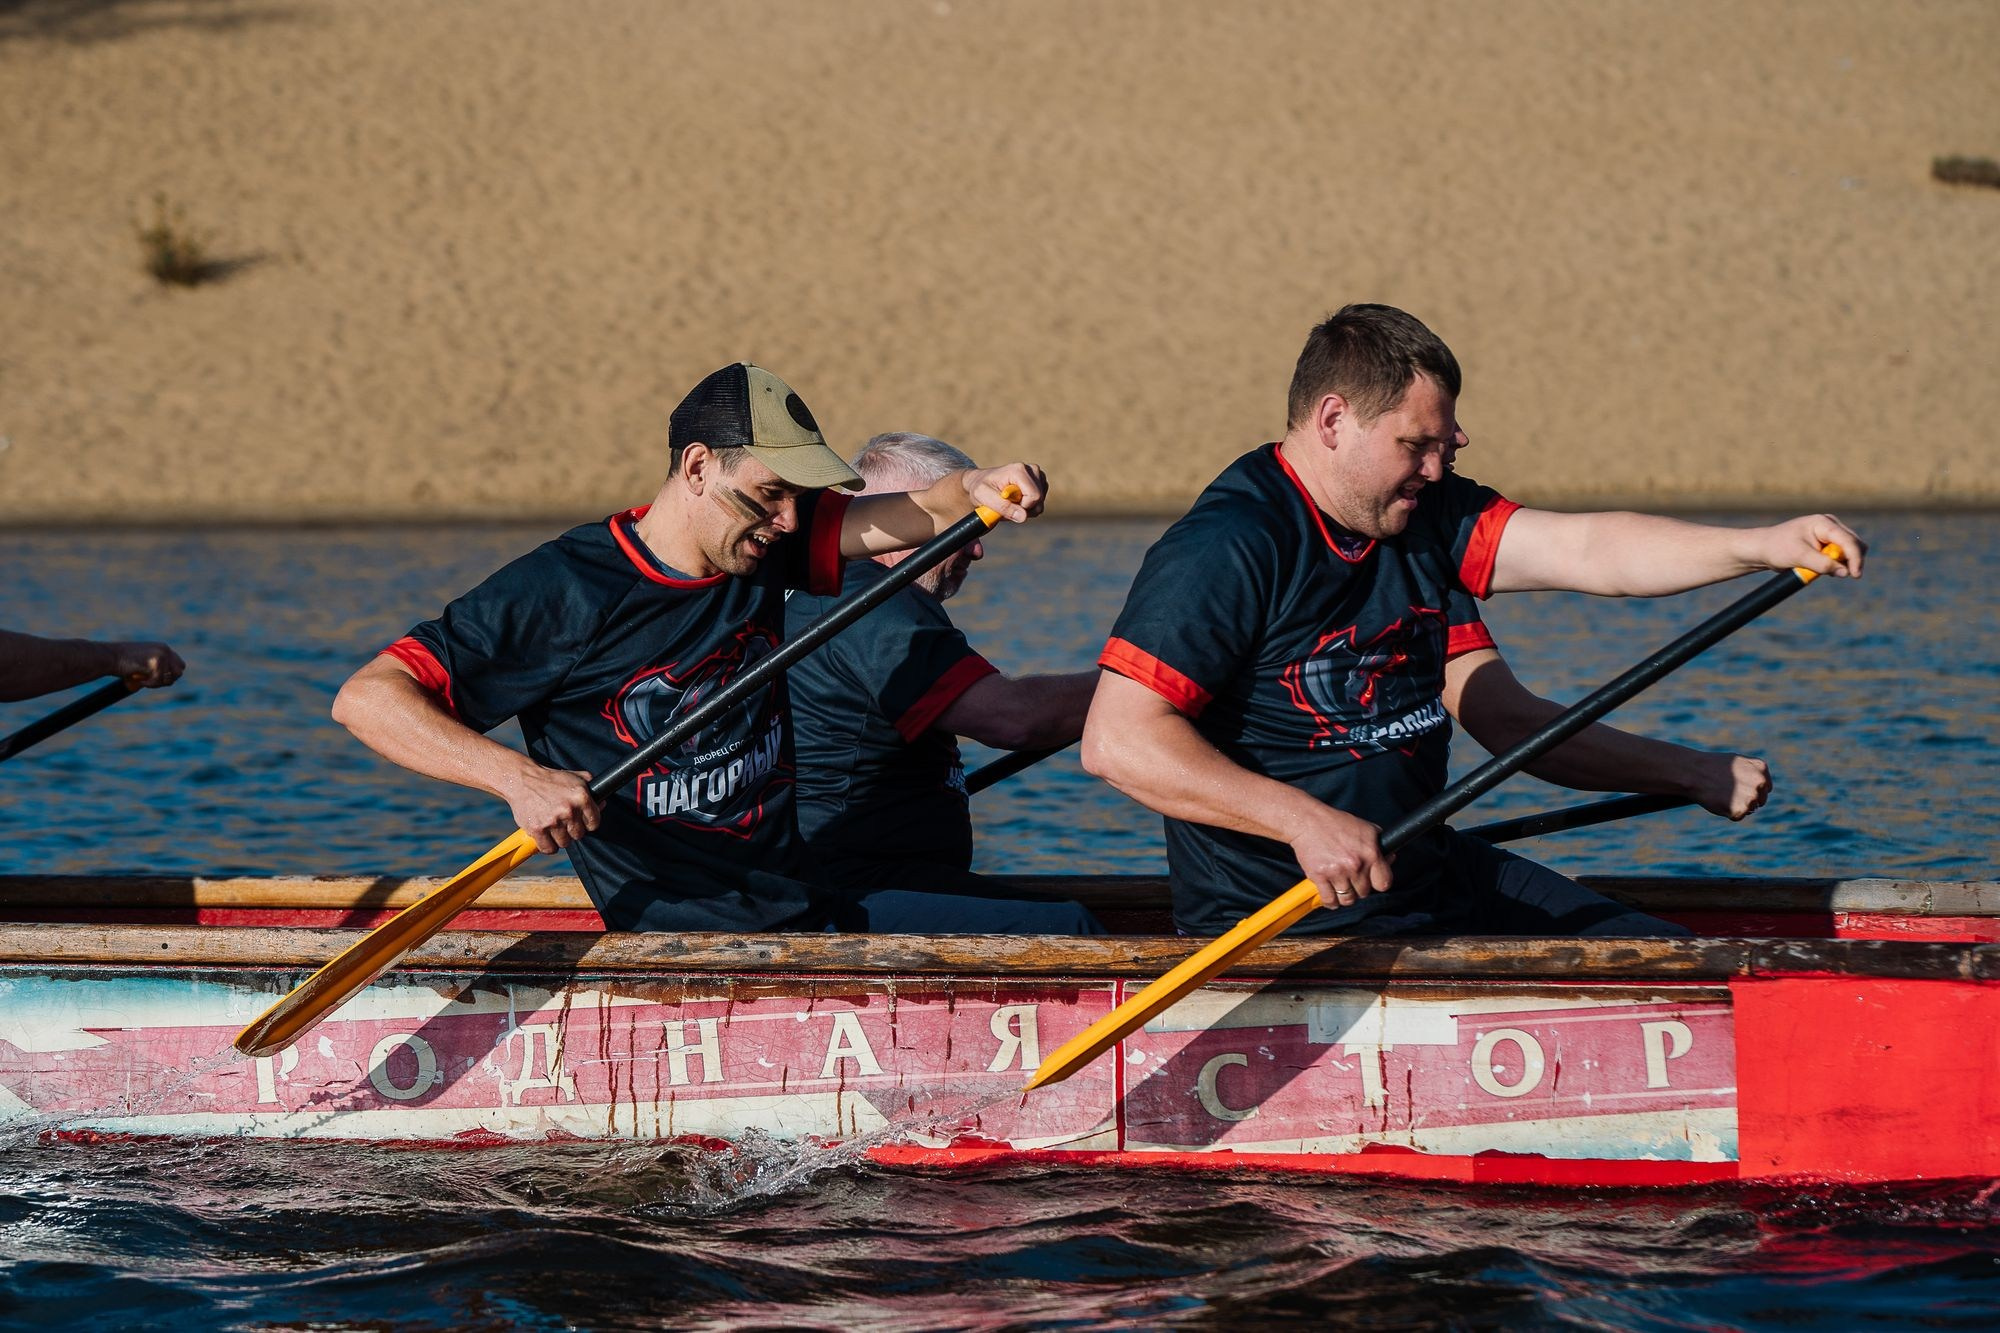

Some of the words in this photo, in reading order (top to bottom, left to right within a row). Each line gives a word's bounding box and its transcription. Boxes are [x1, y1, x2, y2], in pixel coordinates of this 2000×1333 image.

[646, 715, 783, 818] НАГОРНЫЙ
[693, 747, 730, 766] ДВОРЕЦ
[255, 1003, 1041, 1106] РОДНАЯ
[1197, 1020, 1694, 1122] СТОР
